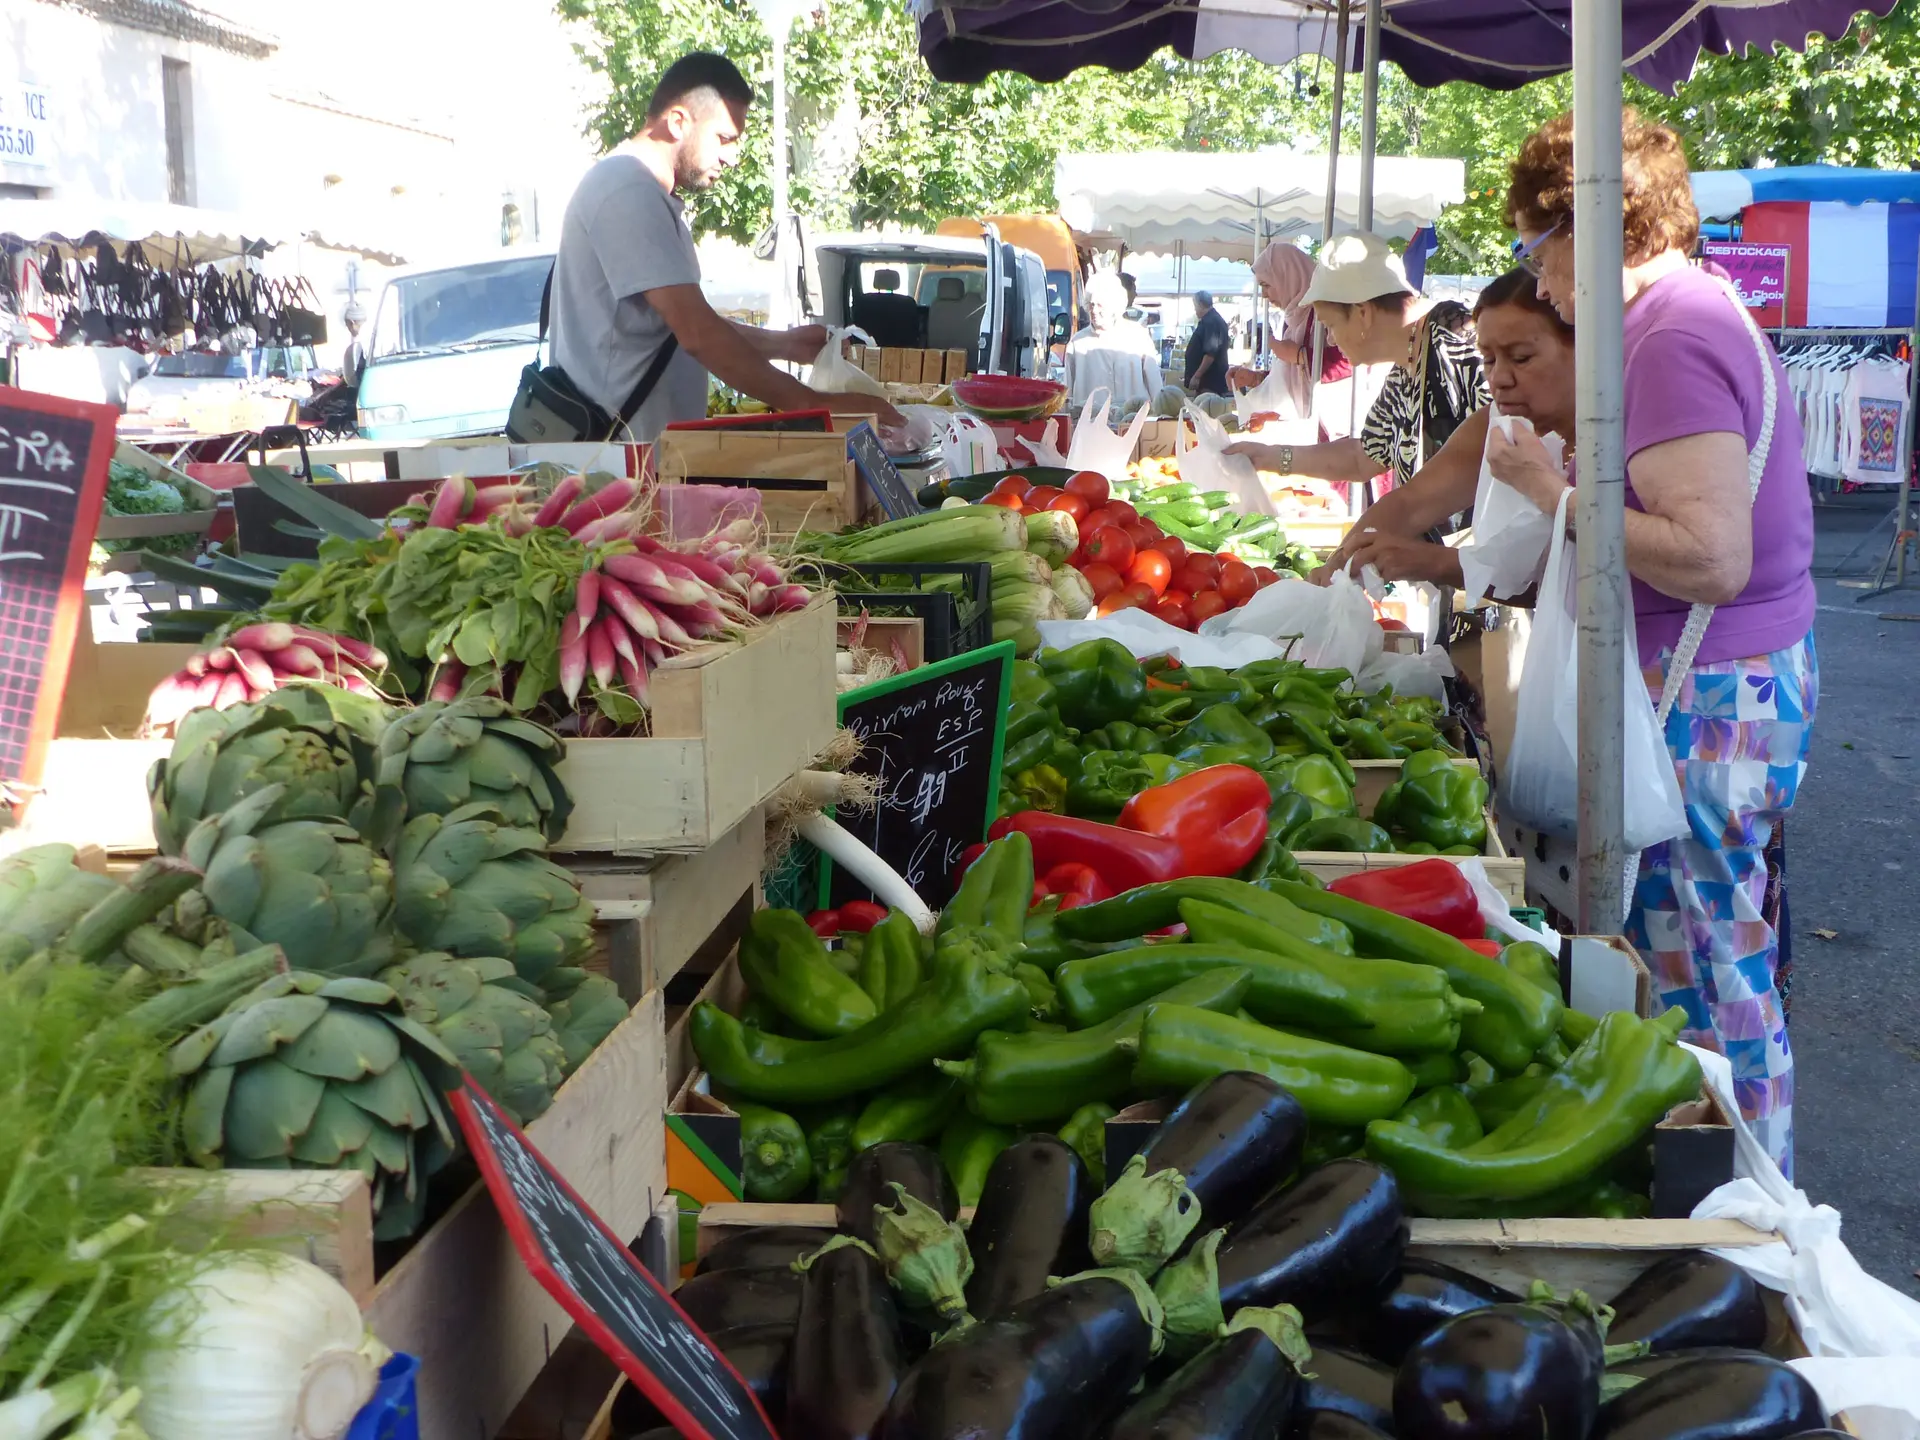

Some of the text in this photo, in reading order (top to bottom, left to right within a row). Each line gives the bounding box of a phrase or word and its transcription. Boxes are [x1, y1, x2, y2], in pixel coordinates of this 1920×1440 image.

[1705, 246, 1788, 257] DESTOCKAGE
[1760, 275, 1778, 286] Au
[1751, 289, 1785, 300] Choix
[936, 708, 983, 741] ESP
[943, 837, 964, 875] K
